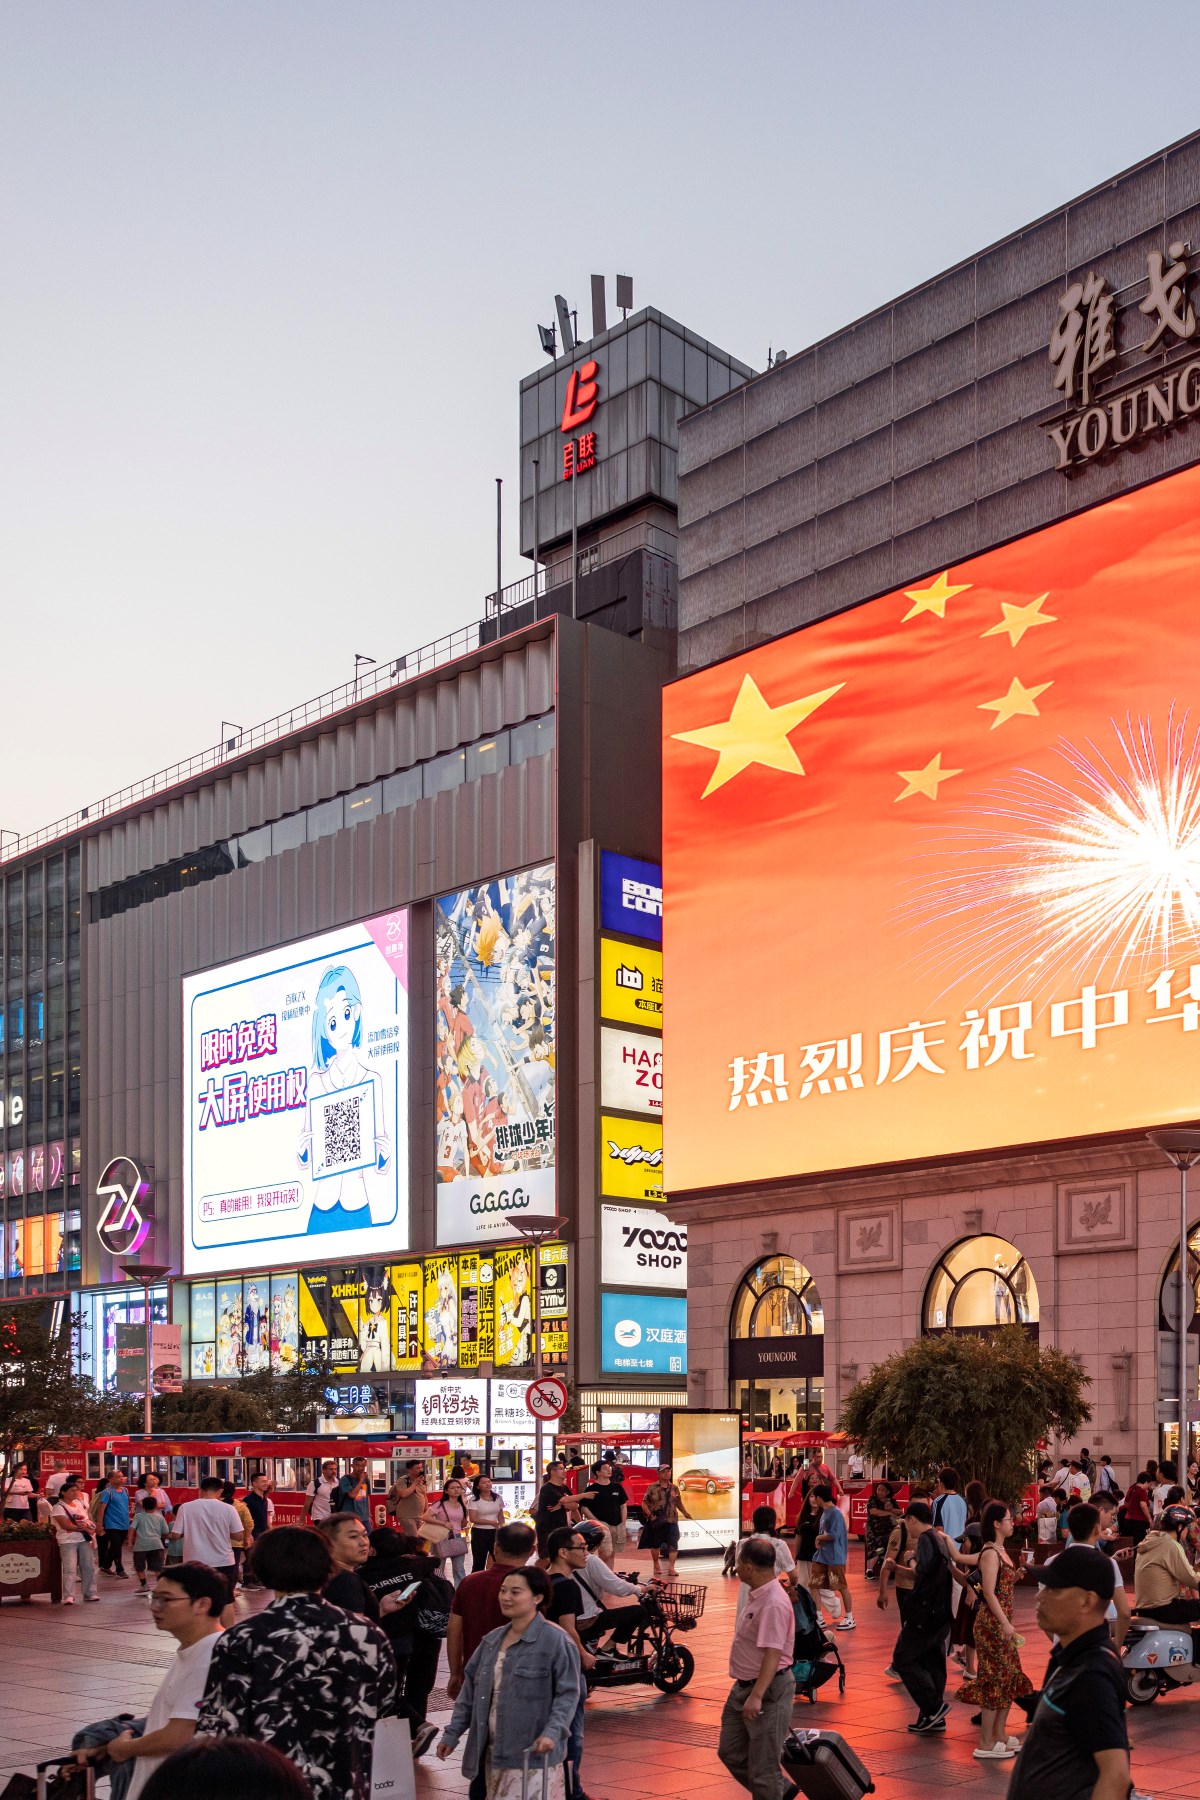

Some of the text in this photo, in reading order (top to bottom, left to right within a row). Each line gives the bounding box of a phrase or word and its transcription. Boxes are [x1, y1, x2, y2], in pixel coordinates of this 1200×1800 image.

[563, 456, 596, 481] BALIAN
[201, 1013, 278, 1072] 限时免费
[198, 1066, 308, 1131] 大屏使用权
[636, 1253, 682, 1270] SHOP
[758, 1351, 797, 1363] YOUNGOR
[422, 1394, 480, 1417] 铜锣烧
